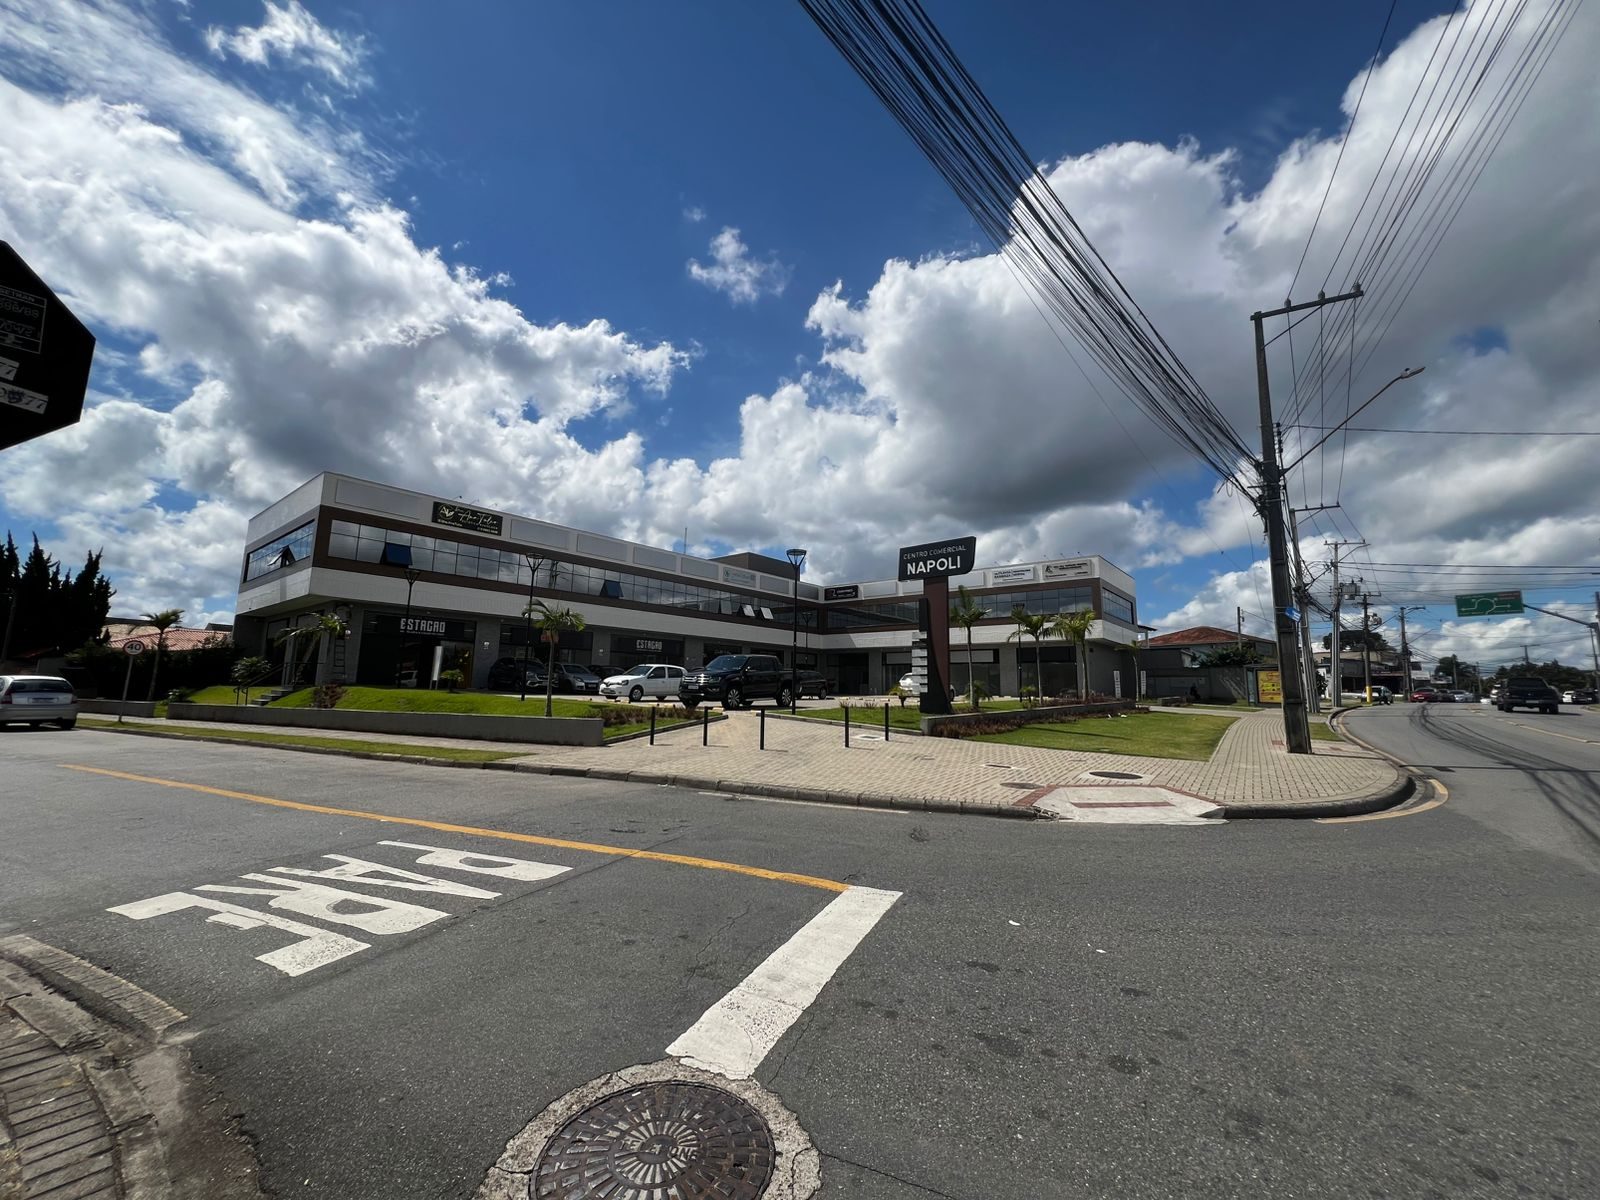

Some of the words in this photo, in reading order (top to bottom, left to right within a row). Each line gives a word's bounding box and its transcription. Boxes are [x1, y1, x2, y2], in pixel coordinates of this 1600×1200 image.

[903, 551, 928, 560] CENTRO
[929, 545, 966, 556] COMERCIAL
[907, 555, 960, 575] NAPOLI
[127, 643, 141, 651] 40
[106, 839, 574, 977] PARE
